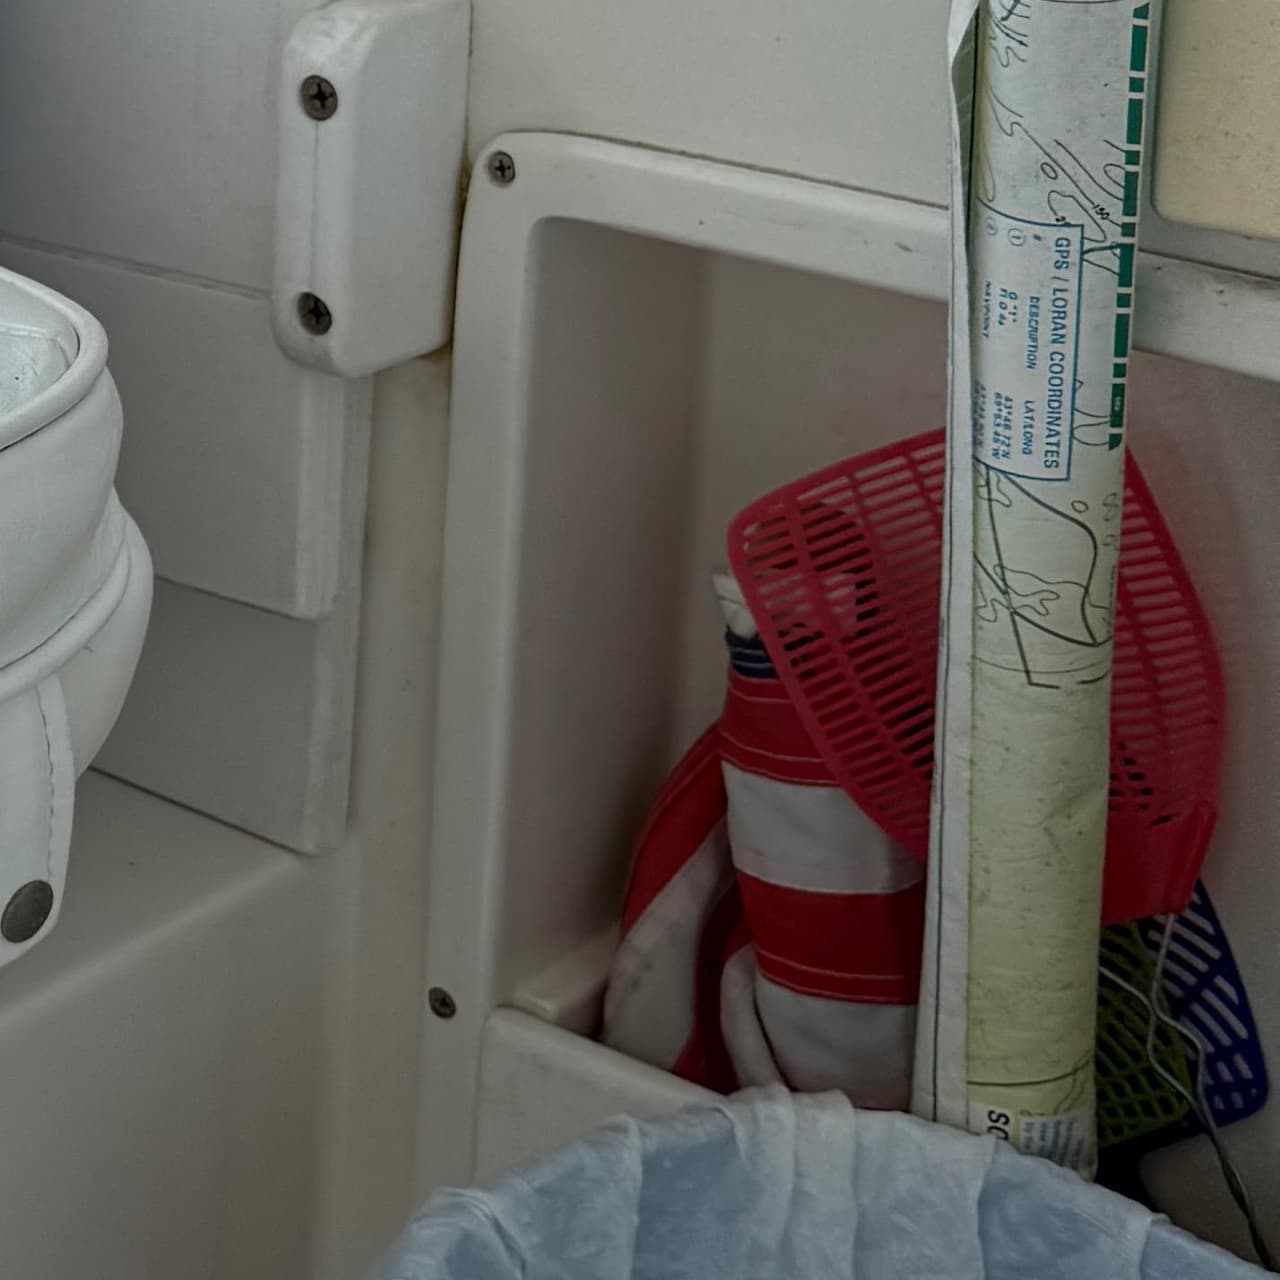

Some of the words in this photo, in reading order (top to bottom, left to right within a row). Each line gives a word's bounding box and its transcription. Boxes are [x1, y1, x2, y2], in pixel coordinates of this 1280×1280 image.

[1052, 236, 1071, 270] GPS
[1026, 295, 1040, 370] DESCRIPTION
[1049, 287, 1069, 345] LORAN
[1021, 400, 1036, 456] LAT/LONG
[1043, 351, 1065, 469] COORDINATES
